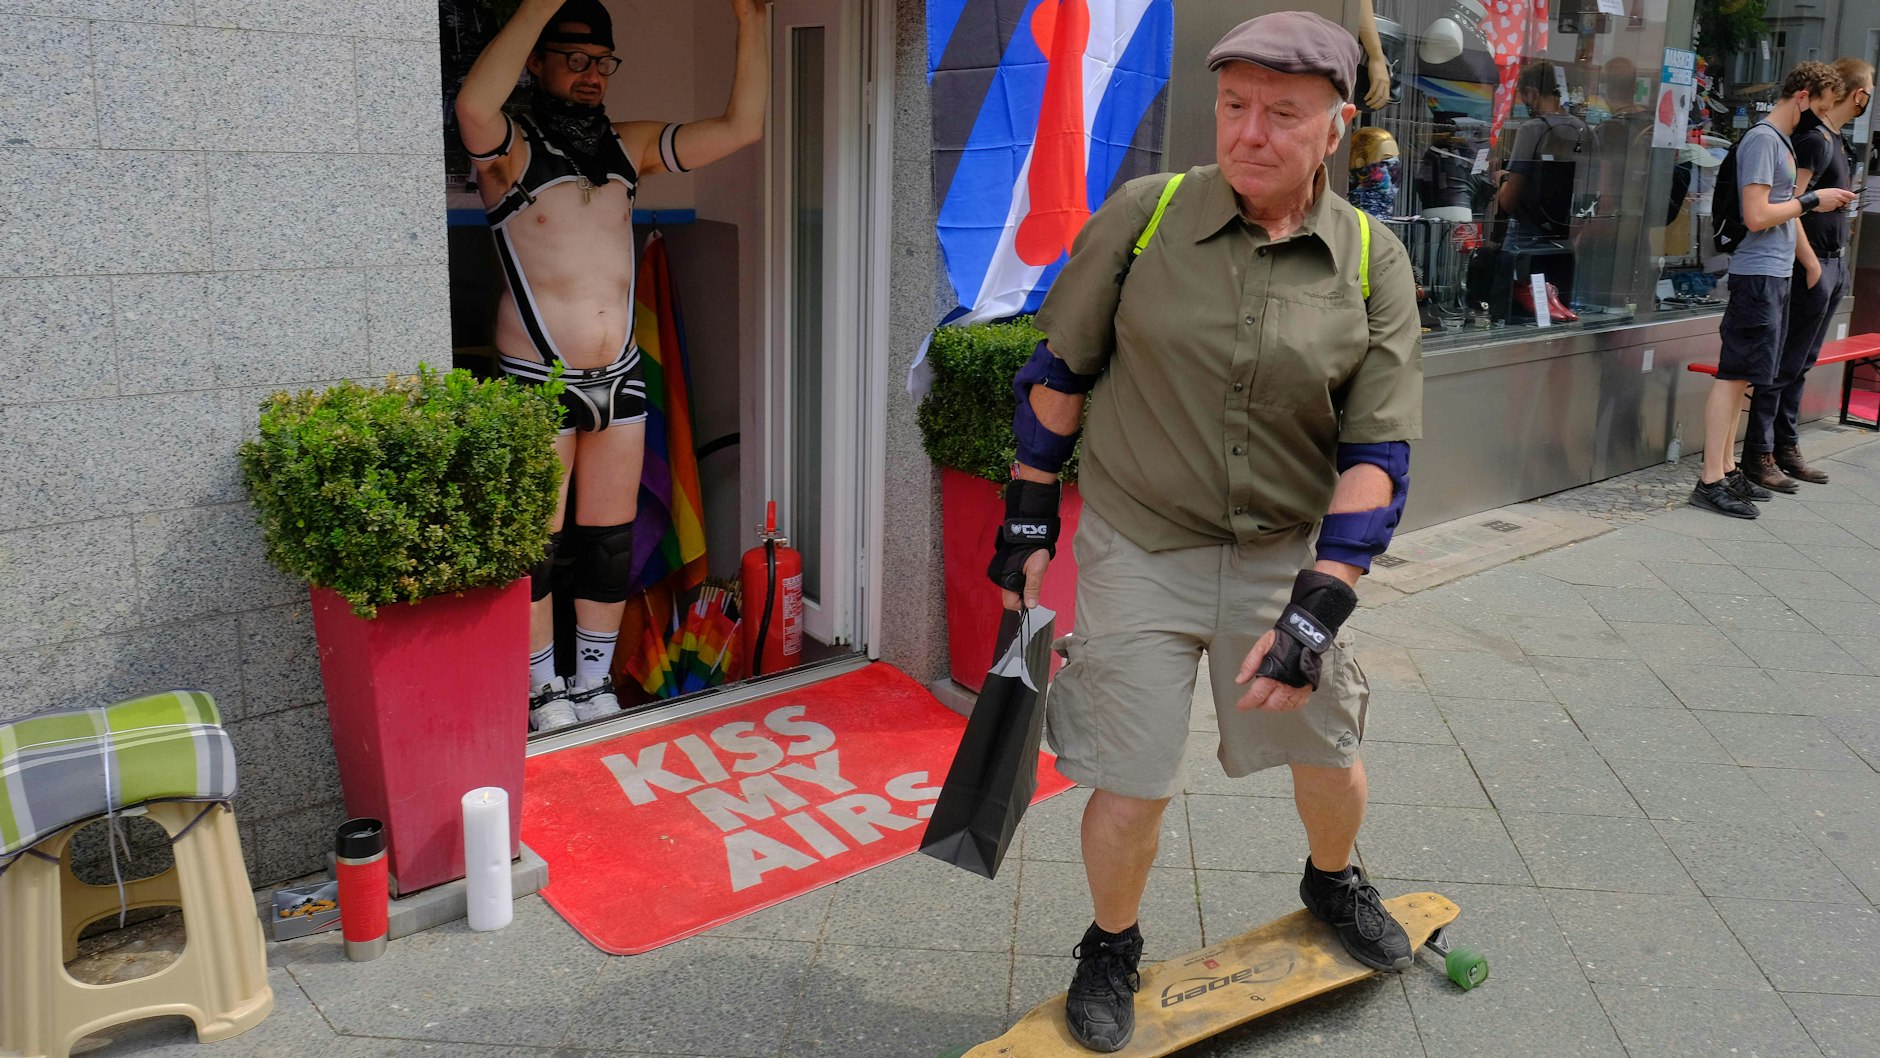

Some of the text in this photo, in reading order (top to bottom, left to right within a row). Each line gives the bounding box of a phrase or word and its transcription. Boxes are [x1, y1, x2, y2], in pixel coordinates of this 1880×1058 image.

[1021, 524, 1048, 535] TSG
[1298, 618, 1326, 644] TSG
[601, 705, 836, 806] KISS
[686, 749, 857, 832] MY
[723, 771, 942, 892] AIRS
